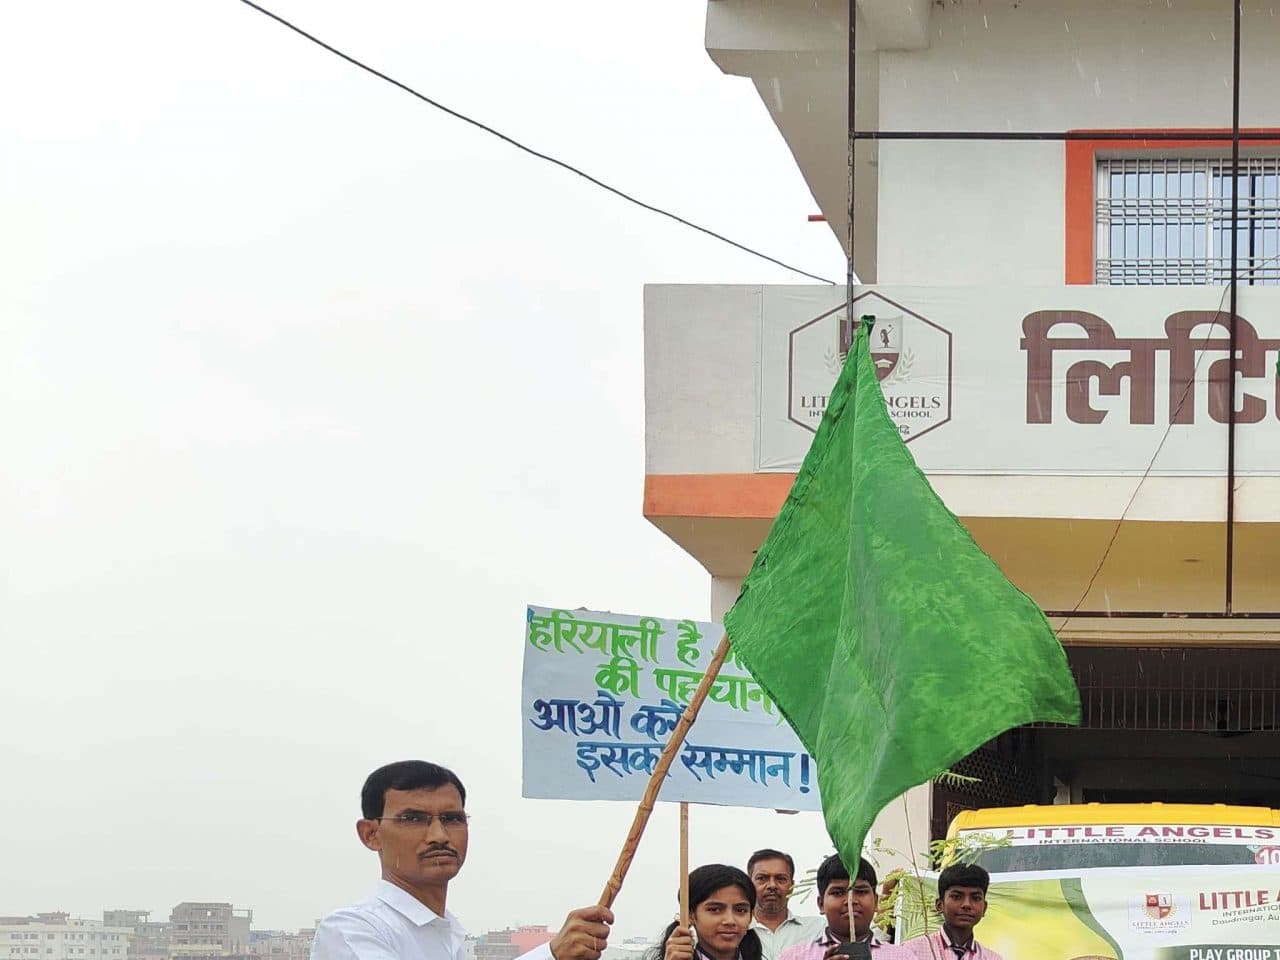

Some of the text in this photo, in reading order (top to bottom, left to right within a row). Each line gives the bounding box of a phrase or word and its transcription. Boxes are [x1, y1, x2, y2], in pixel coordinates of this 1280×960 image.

[802, 396, 941, 409] LIT NGELS
[891, 410, 932, 418] SCHOOL
[529, 609, 666, 664] हरियाली
[677, 619, 703, 668] है
[594, 656, 644, 699] की
[529, 690, 625, 739] आओ
[576, 741, 672, 783] इसक
[1006, 826, 1276, 839] LITTLE ANGELS
[1199, 889, 1269, 910] LITTLE
[1212, 914, 1266, 925] Daudnagar,
